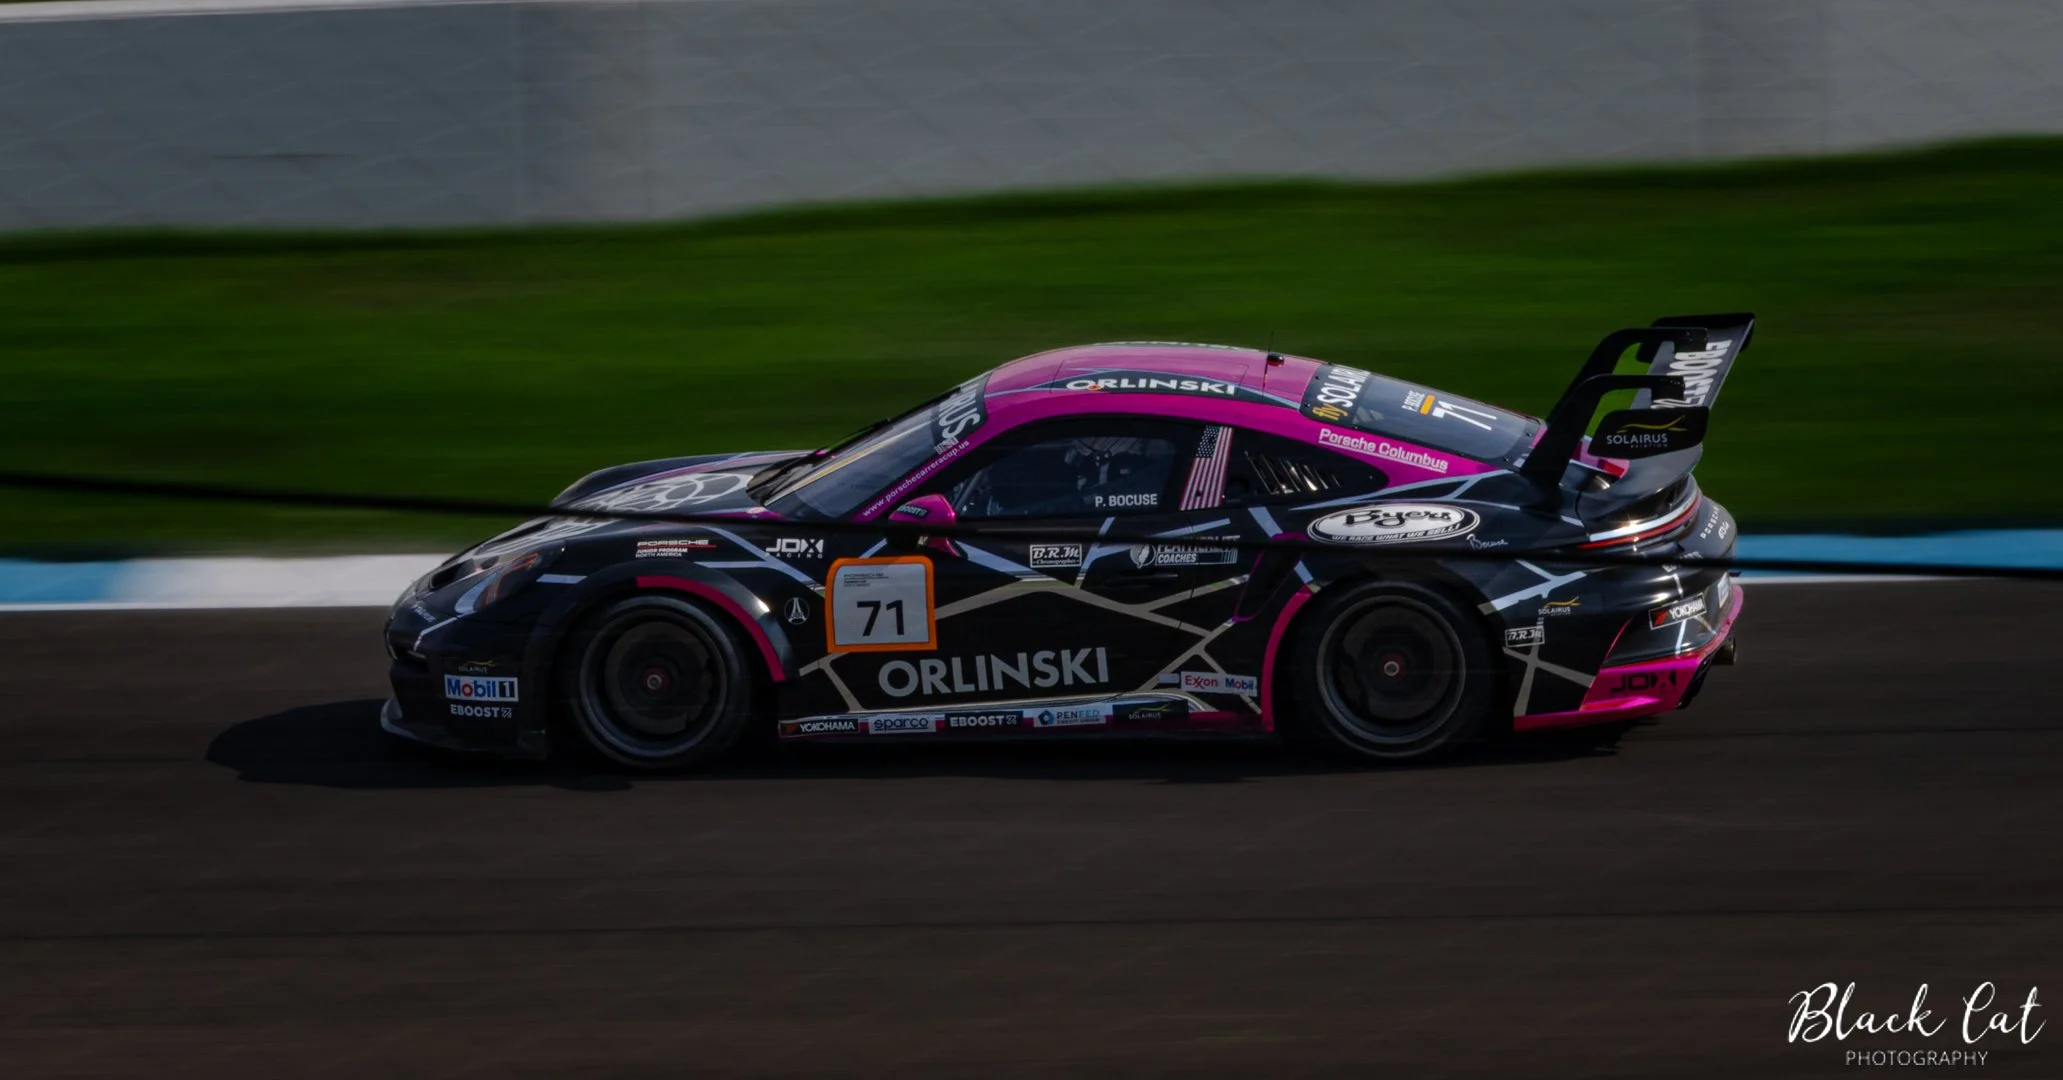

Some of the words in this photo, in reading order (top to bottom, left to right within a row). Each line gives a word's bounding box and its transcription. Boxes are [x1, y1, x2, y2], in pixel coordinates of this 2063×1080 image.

[1066, 378, 1235, 395] ORLINSKI
[1432, 400, 1497, 431] 71
[1606, 433, 1668, 445] SOLAIRUS
[1319, 428, 1376, 453] Porsche
[1378, 442, 1449, 471] Columbus
[862, 440, 970, 517] www.porschecarreracup.us
[1095, 496, 1106, 508] P.
[1109, 493, 1158, 506] BOCUSE
[1345, 508, 1452, 528] Byers
[637, 539, 709, 547] PORSCHE
[1375, 533, 1405, 541] WHAT
[1406, 531, 1425, 539] WE
[766, 538, 824, 553] JDX
[1157, 553, 1197, 564] COACHES
[1538, 606, 1571, 615] SOLAIRUS
[1669, 596, 1704, 619] YOKOHAMA
[857, 600, 904, 636] 71
[878, 646, 1109, 697] ORLINSKI
[447, 678, 496, 698] Mobil
[503, 681, 511, 697] 1
[1185, 675, 1218, 689] Exxon
[1225, 677, 1254, 690] Mobil
[450, 703, 500, 718] EBOOST
[1056, 710, 1100, 719] PENFED
[799, 720, 855, 733] YOKOHAMA
[874, 716, 929, 730] sparco
[950, 715, 1004, 727] EBOOST
